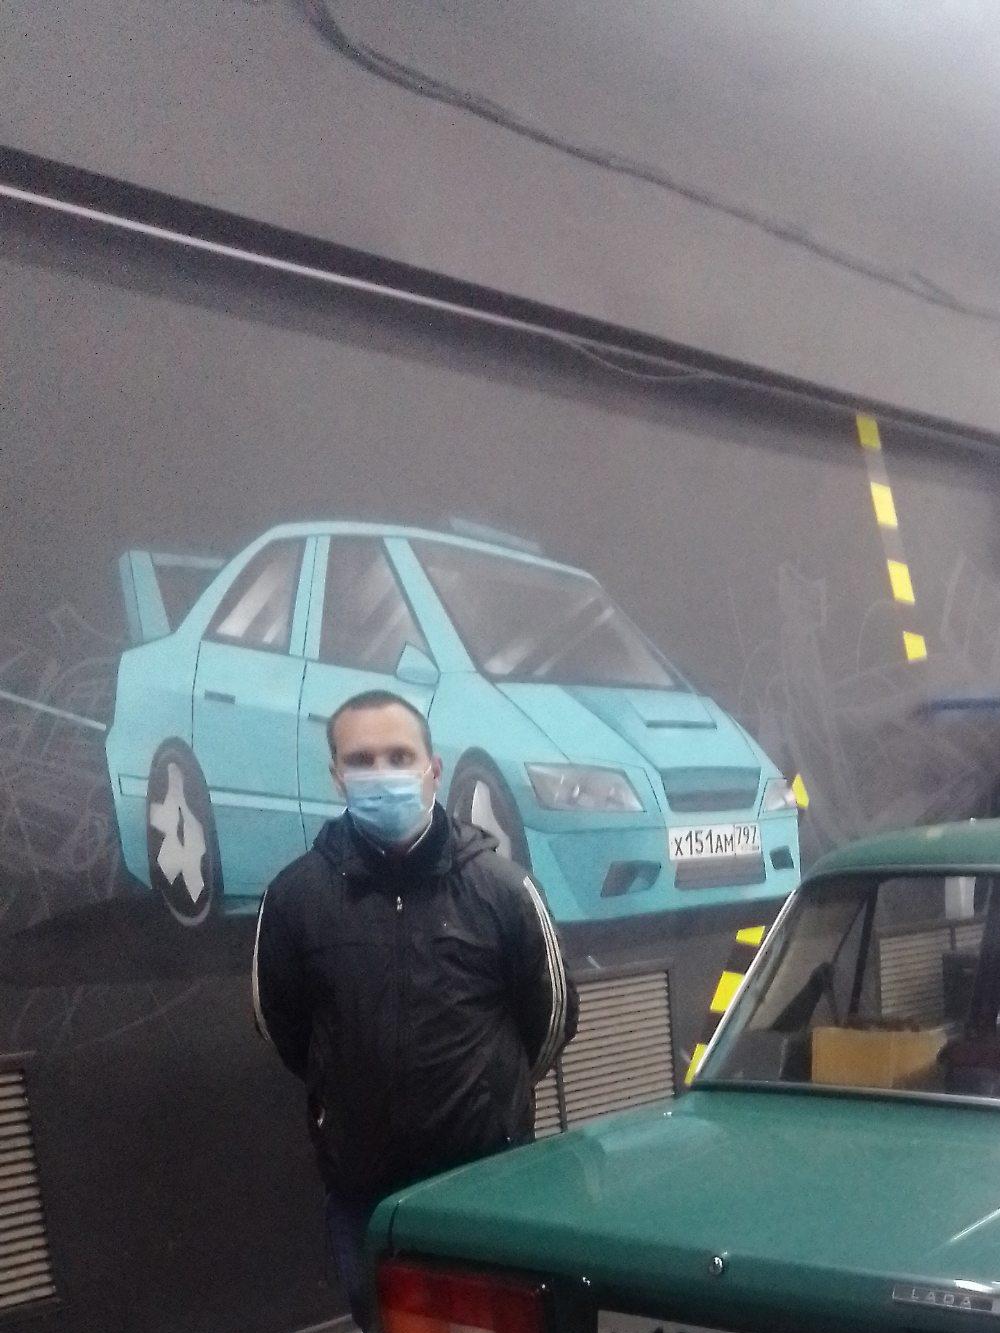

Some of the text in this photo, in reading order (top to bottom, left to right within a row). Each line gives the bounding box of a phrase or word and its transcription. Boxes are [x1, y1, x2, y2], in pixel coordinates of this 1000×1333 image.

[674, 829, 734, 856] Х151АМ
[736, 826, 757, 845] 797
[911, 1288, 972, 1310] LADA
